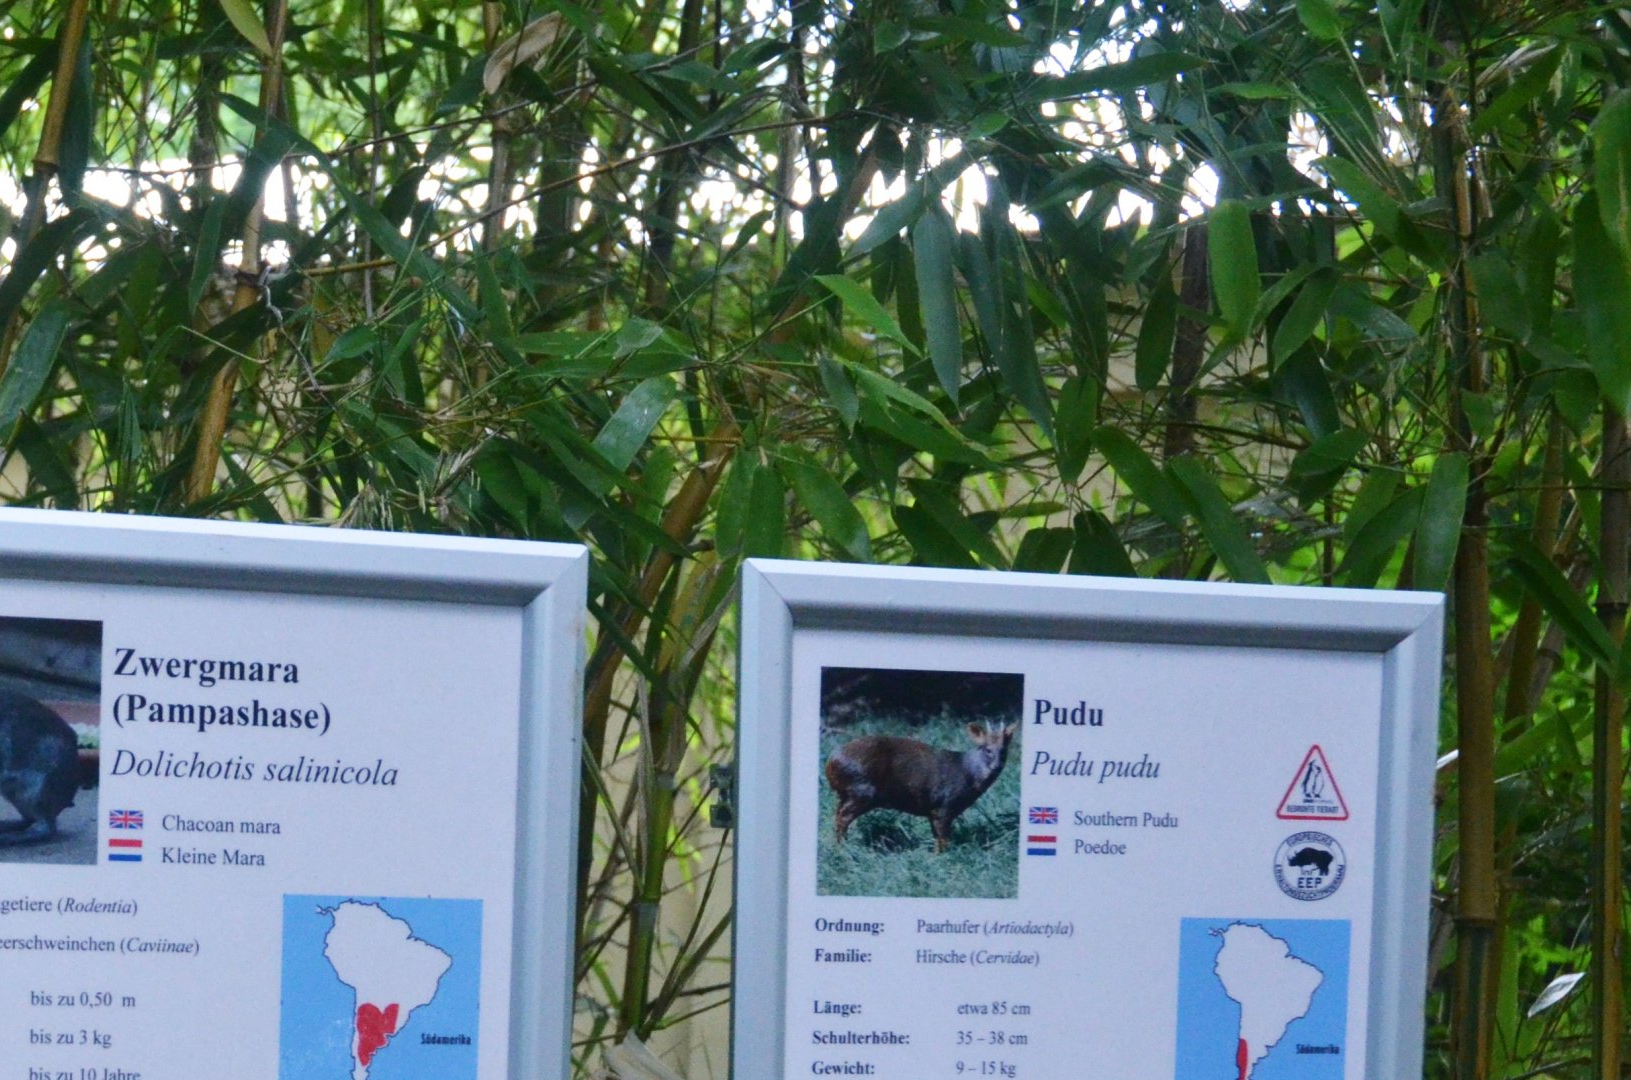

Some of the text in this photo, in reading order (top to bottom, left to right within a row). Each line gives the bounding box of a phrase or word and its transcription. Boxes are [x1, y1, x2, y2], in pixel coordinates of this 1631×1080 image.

[114, 648, 298, 688] Zwergmara
[113, 693, 330, 736] (Pampashase)
[1034, 699, 1103, 727] Pudu
[111, 749, 398, 787] Dolichotis salinicola
[1030, 750, 1160, 784] Pudu pudu
[162, 813, 281, 835] Chacoan mara
[1074, 809, 1178, 829] Southern Pudu
[162, 847, 265, 867] Kleine Mara
[1075, 838, 1126, 856] Poedoe
[1296, 874, 1324, 892] EEP
[57, 896, 138, 916] (Rodentia)
[814, 917, 884, 937] Ordnung:
[917, 918, 1074, 938] Paarhufer (Artiodactyla)
[119, 936, 200, 956] (Caviinae)
[815, 948, 872, 963] Familie:
[916, 949, 1040, 967] Hirsche (Cervidae)
[30, 990, 136, 1008] bis zu 0,50 m
[814, 999, 861, 1018] Länge:
[957, 1000, 1031, 1016] etwa 85 cm
[30, 1028, 112, 1050] bis zu 3 kg
[421, 1032, 472, 1047] Südamerika
[812, 1030, 909, 1045] Schulterhöhe:
[957, 1030, 973, 1045] 35
[989, 1030, 1005, 1046] 38
[1008, 1034, 1028, 1046] cm
[811, 1060, 874, 1076] Gewicht:
[955, 1060, 965, 1075] 9
[982, 1060, 996, 1076] 15
[1000, 1060, 1016, 1079] kg
